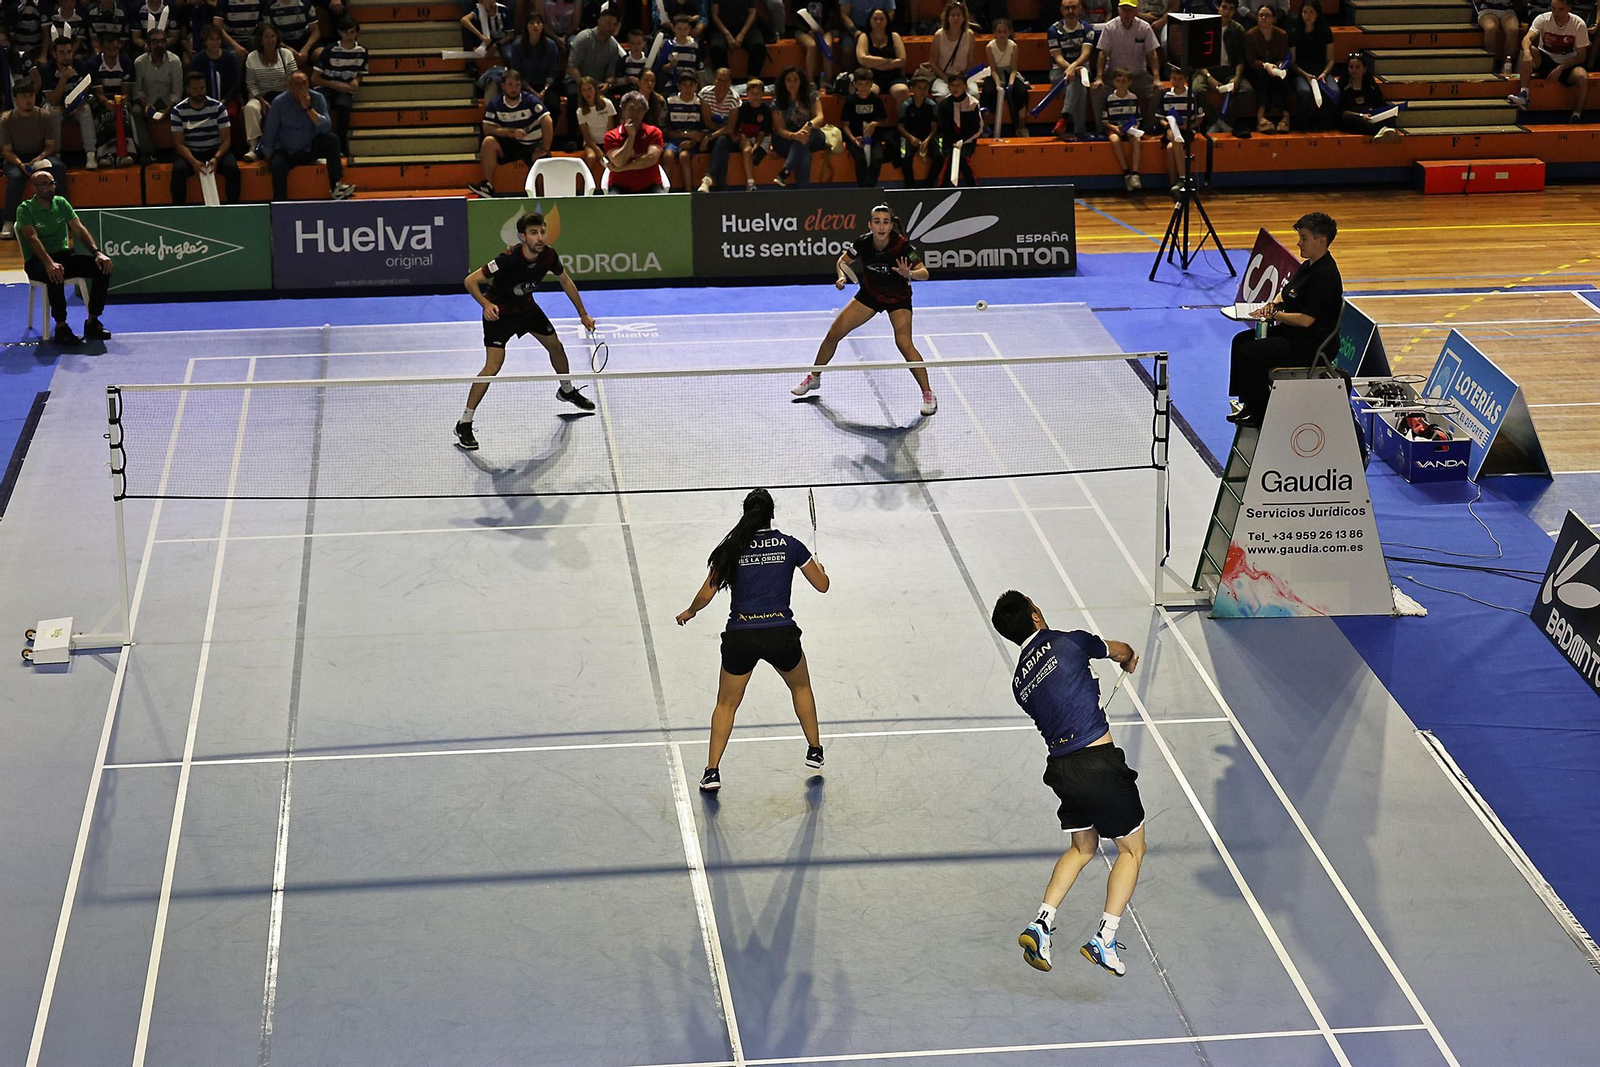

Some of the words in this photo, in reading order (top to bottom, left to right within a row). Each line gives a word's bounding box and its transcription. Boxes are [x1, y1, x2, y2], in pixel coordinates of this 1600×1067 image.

[722, 213, 798, 233] Huelva
[804, 208, 857, 231] eleva
[295, 216, 432, 254] Huelva
[1016, 231, 1069, 243] ESPAÑA
[105, 241, 119, 256] El
[121, 241, 155, 256] Corte
[722, 242, 755, 258] tus
[760, 237, 853, 256] sentidos
[924, 246, 1069, 268] BADMINTON
[385, 254, 433, 269] original
[557, 252, 662, 274] RDROLA
[1454, 371, 1502, 424] LOTERÍAS
[1464, 417, 1484, 439] DEPORTE
[1416, 460, 1467, 468] VANDA
[1261, 469, 1353, 492] Gaudia
[1246, 508, 1305, 518] Servicios
[1308, 506, 1366, 517] Jurídicos
[1248, 532, 1270, 542] Tel_
[1272, 532, 1293, 540] +34
[1296, 531, 1317, 540] 959
[1319, 531, 1333, 539] 26
[1335, 530, 1347, 539] 13
[1349, 530, 1363, 538] 86
[1247, 544, 1363, 555] www.gaudia.com.es
[1014, 676, 1022, 688] P.
[1021, 641, 1052, 680] ABIÁN
